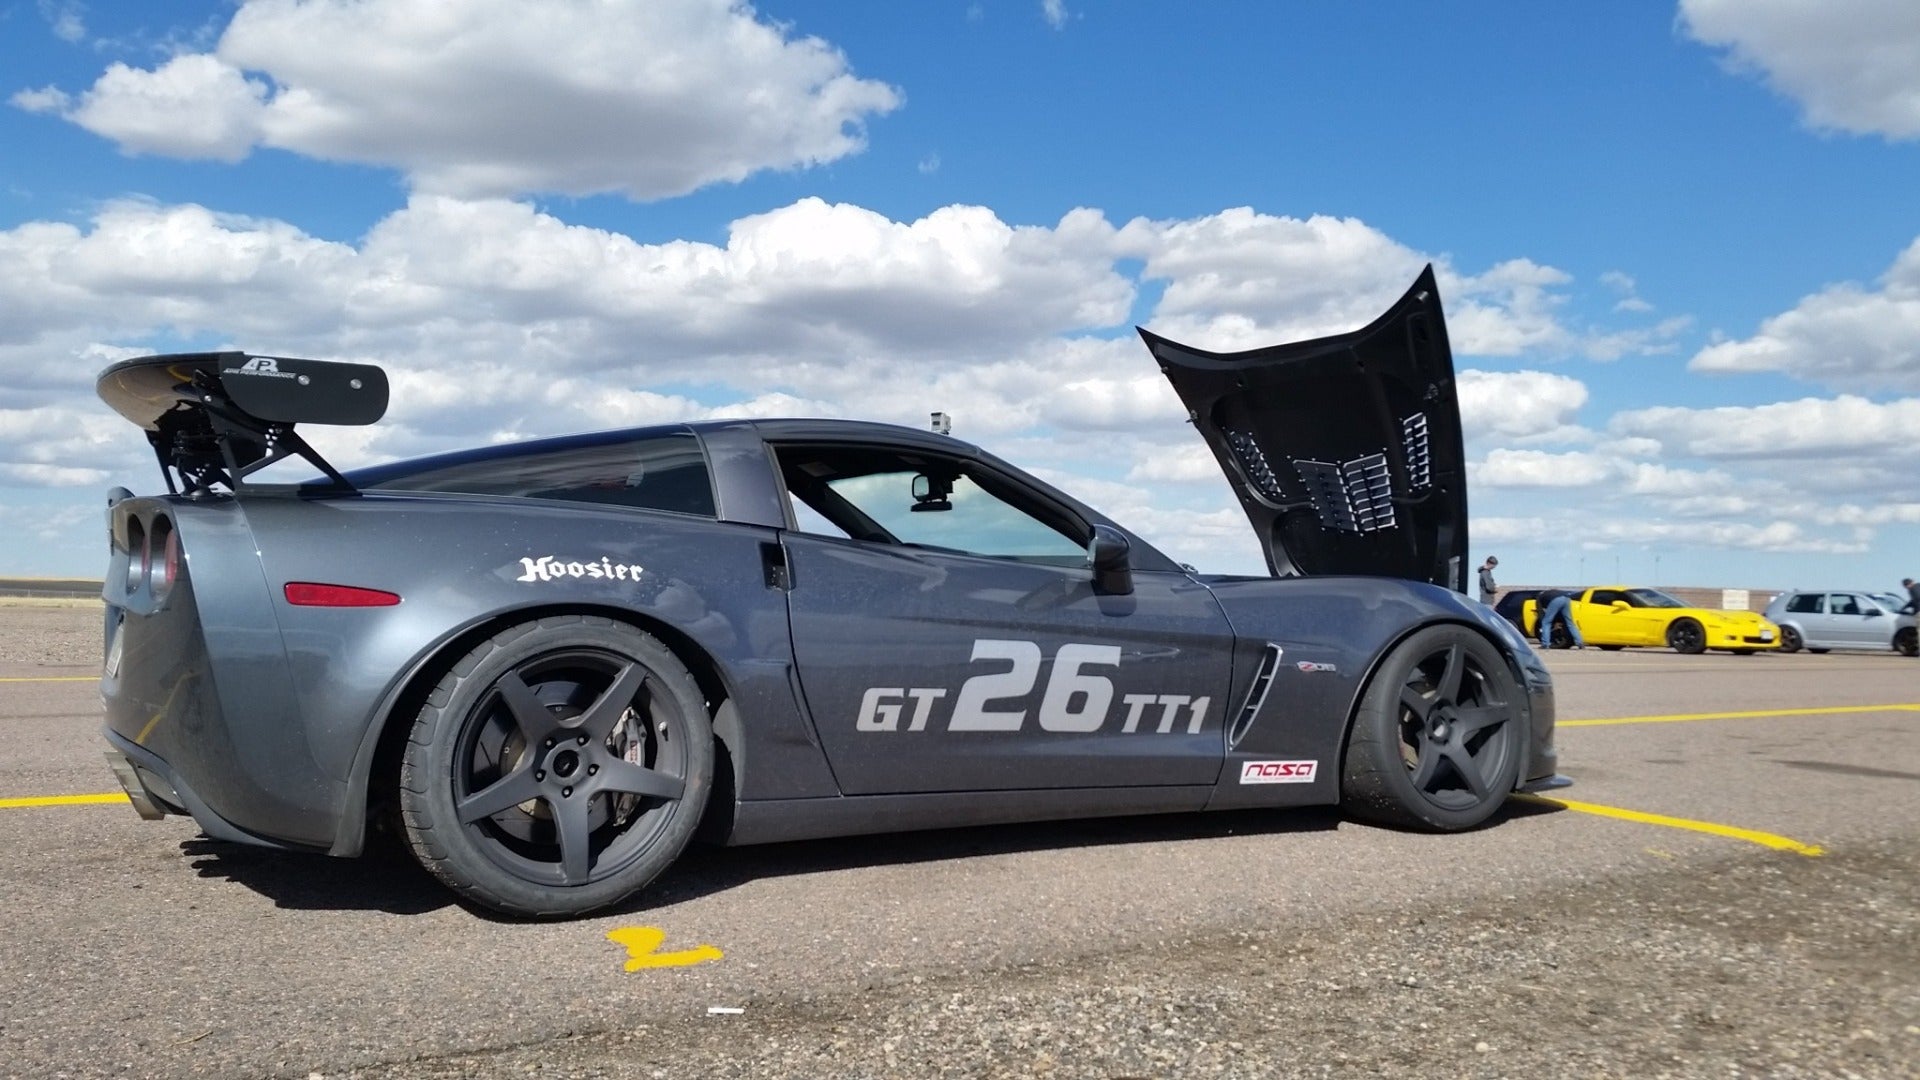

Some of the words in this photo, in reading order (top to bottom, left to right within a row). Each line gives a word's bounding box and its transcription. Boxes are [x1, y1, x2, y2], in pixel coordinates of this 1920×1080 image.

[517, 555, 643, 582] Hoosier
[856, 687, 947, 732] GT
[948, 639, 1122, 732] 26
[1121, 694, 1211, 734] TT1
